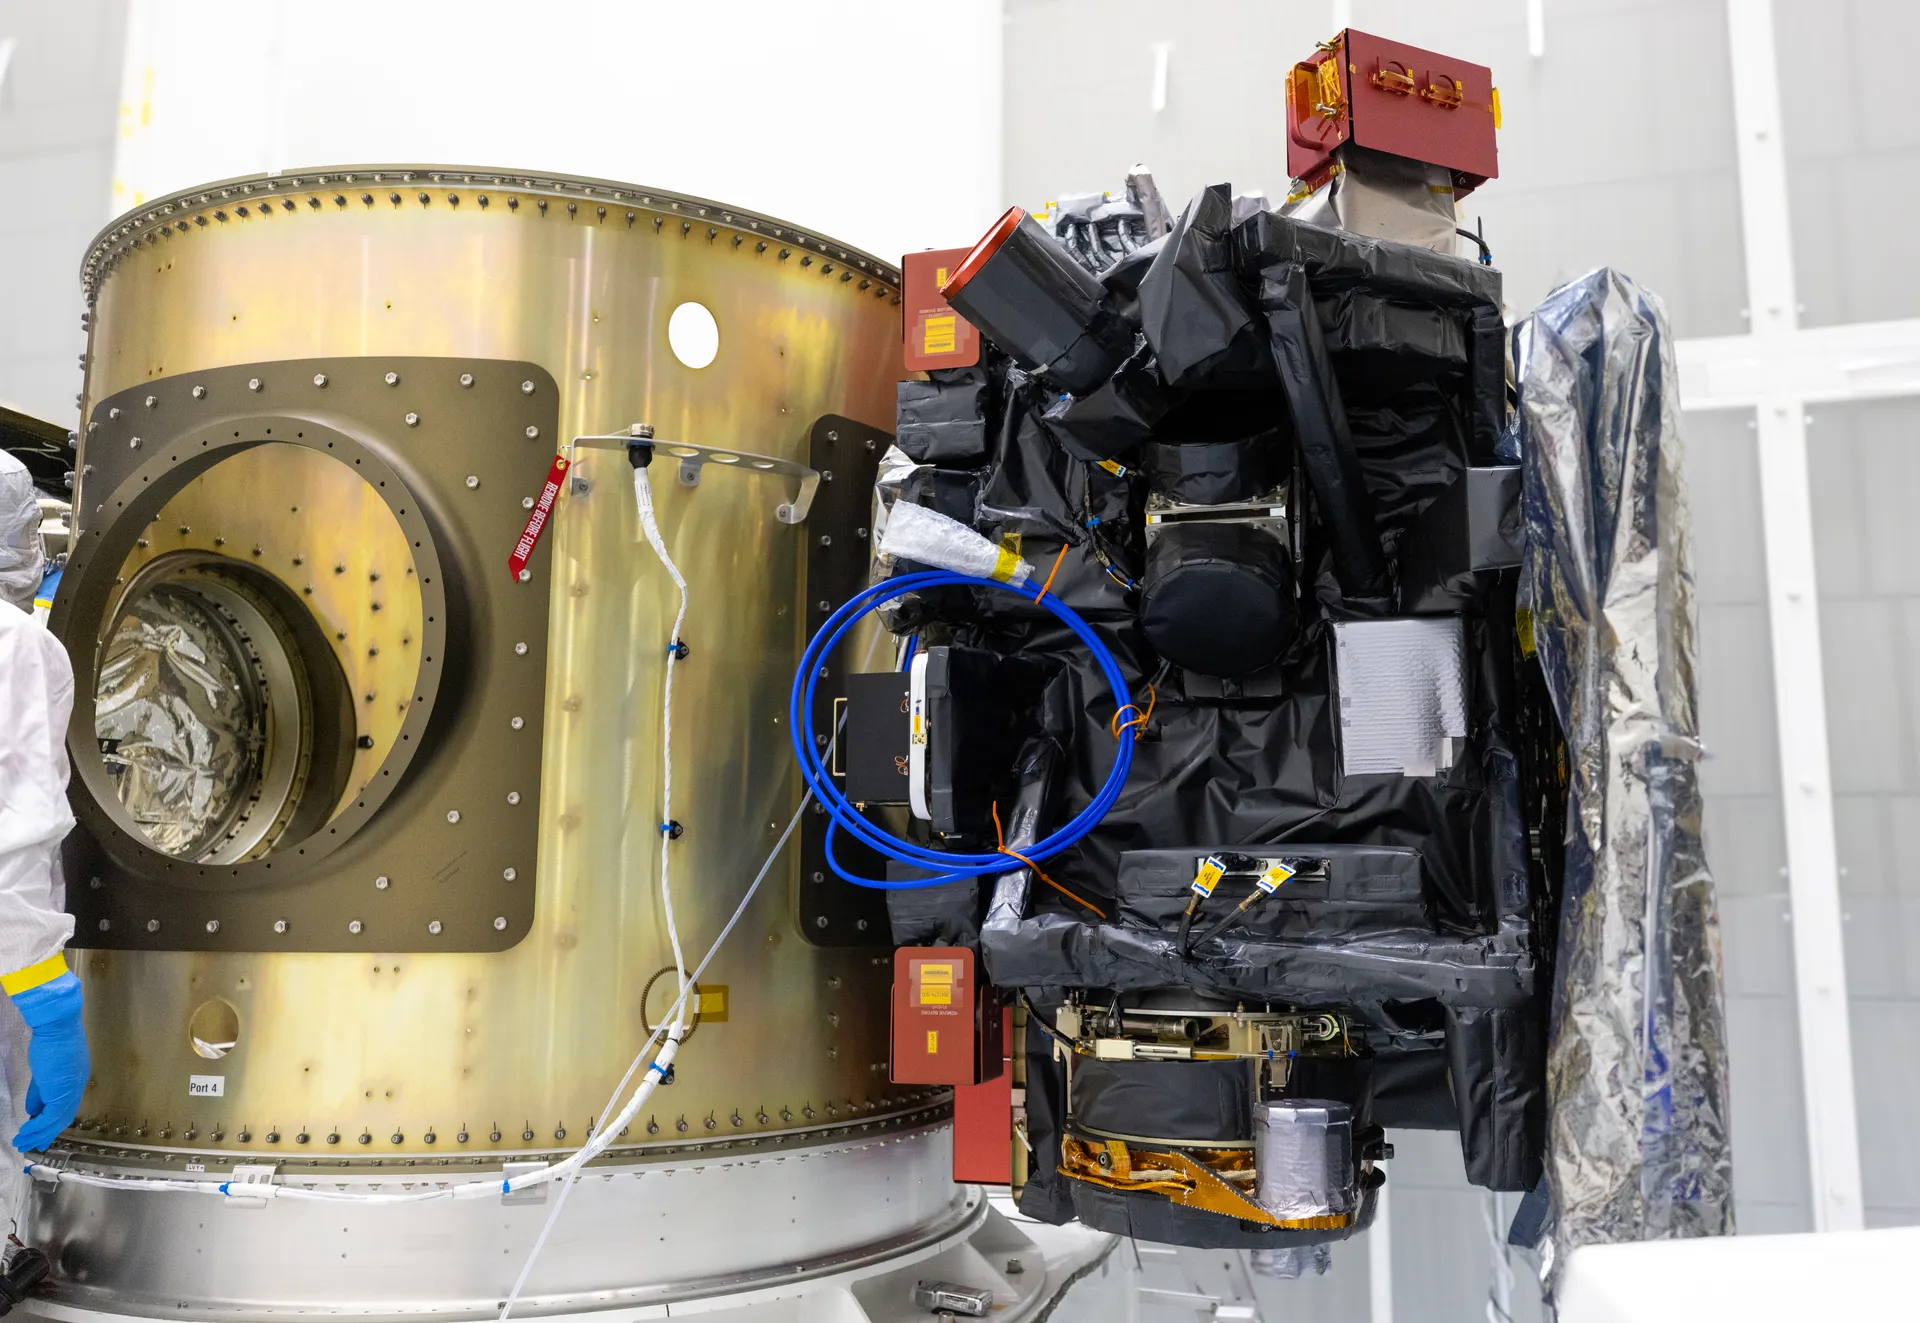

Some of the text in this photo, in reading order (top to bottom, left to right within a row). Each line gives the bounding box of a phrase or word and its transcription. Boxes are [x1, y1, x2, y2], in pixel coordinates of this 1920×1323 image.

[514, 481, 558, 562] REMOVE BEFORE FLIGHT
[190, 1083, 217, 1093] Port 4
